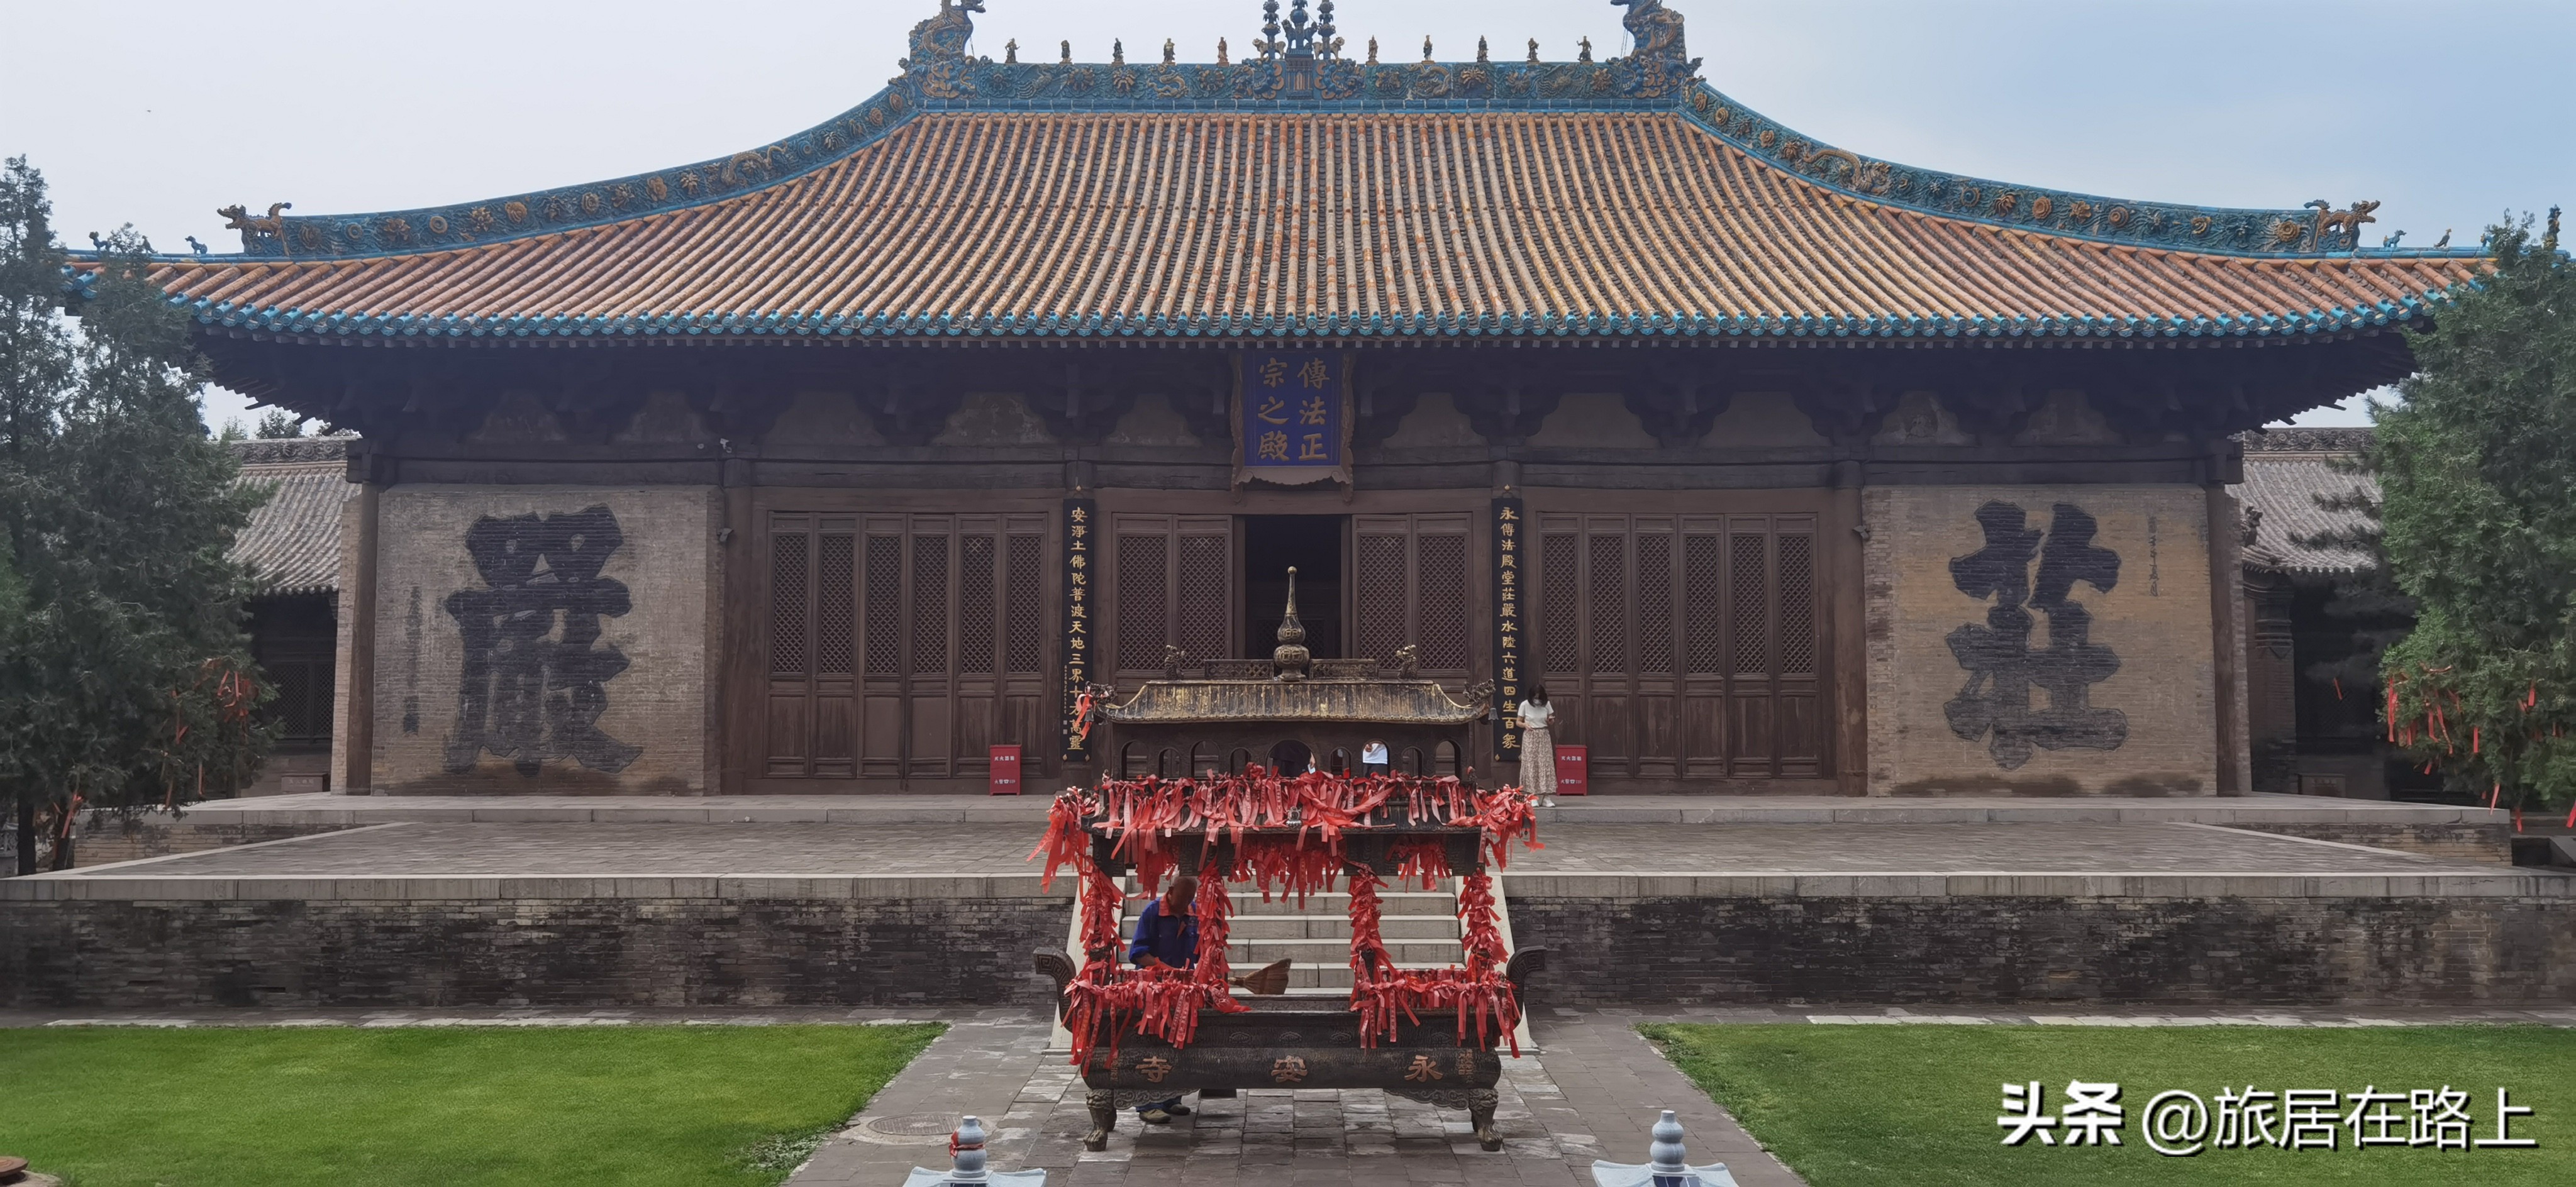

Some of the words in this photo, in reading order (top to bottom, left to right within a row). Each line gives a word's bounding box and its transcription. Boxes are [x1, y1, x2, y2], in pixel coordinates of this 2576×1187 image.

[1257, 357, 1289, 461] 宗之殿
[1297, 357, 1330, 461] 傳法正
